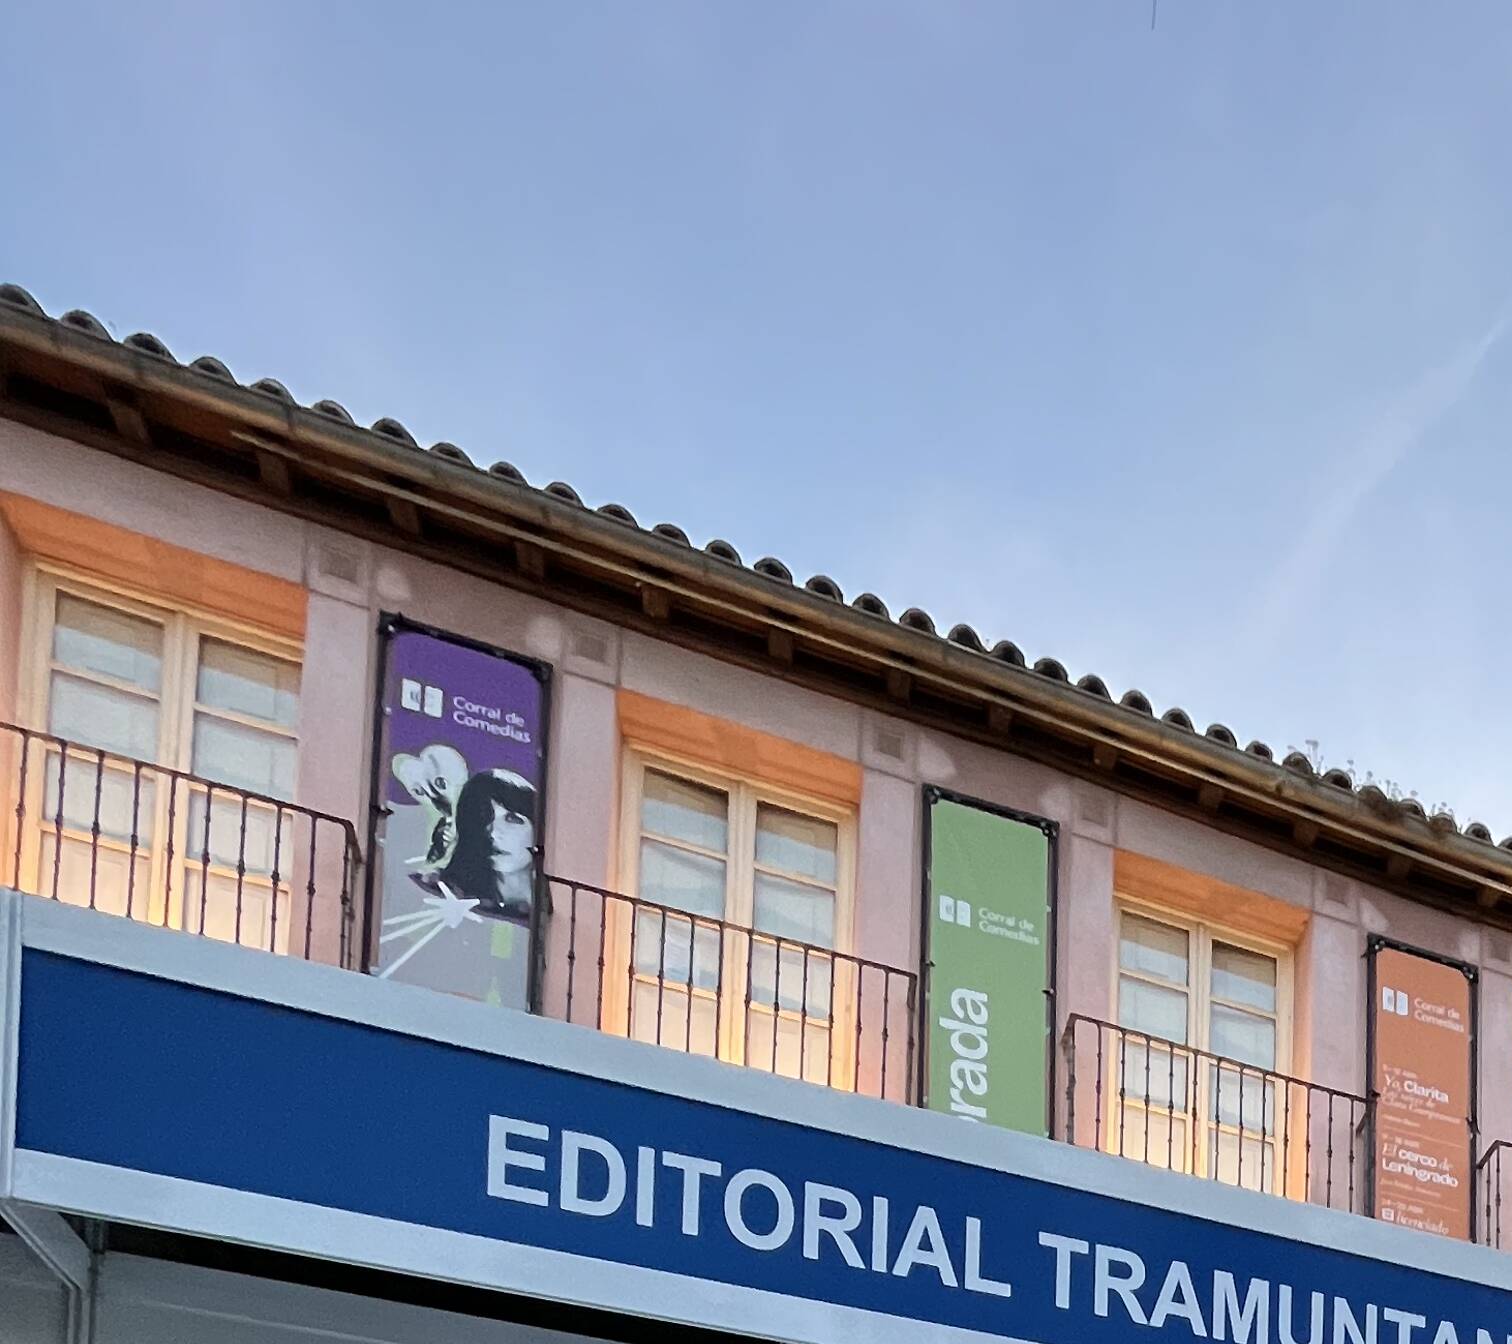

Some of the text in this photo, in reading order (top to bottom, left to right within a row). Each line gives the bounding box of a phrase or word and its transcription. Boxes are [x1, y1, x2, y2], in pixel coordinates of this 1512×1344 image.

[453, 696, 525, 727] Corral de
[453, 711, 531, 743] Comedias
[978, 907, 1035, 931] Corral de
[978, 920, 1040, 946] Comedias
[1414, 998, 1461, 1020] Corral de
[1414, 1010, 1465, 1033] Comedias
[1403, 1080, 1450, 1104] Clarita
[1399, 1149, 1438, 1168] cerco
[1382, 1158, 1459, 1188] Leningrado
[486, 1114, 1011, 1298] EDITORIAL
